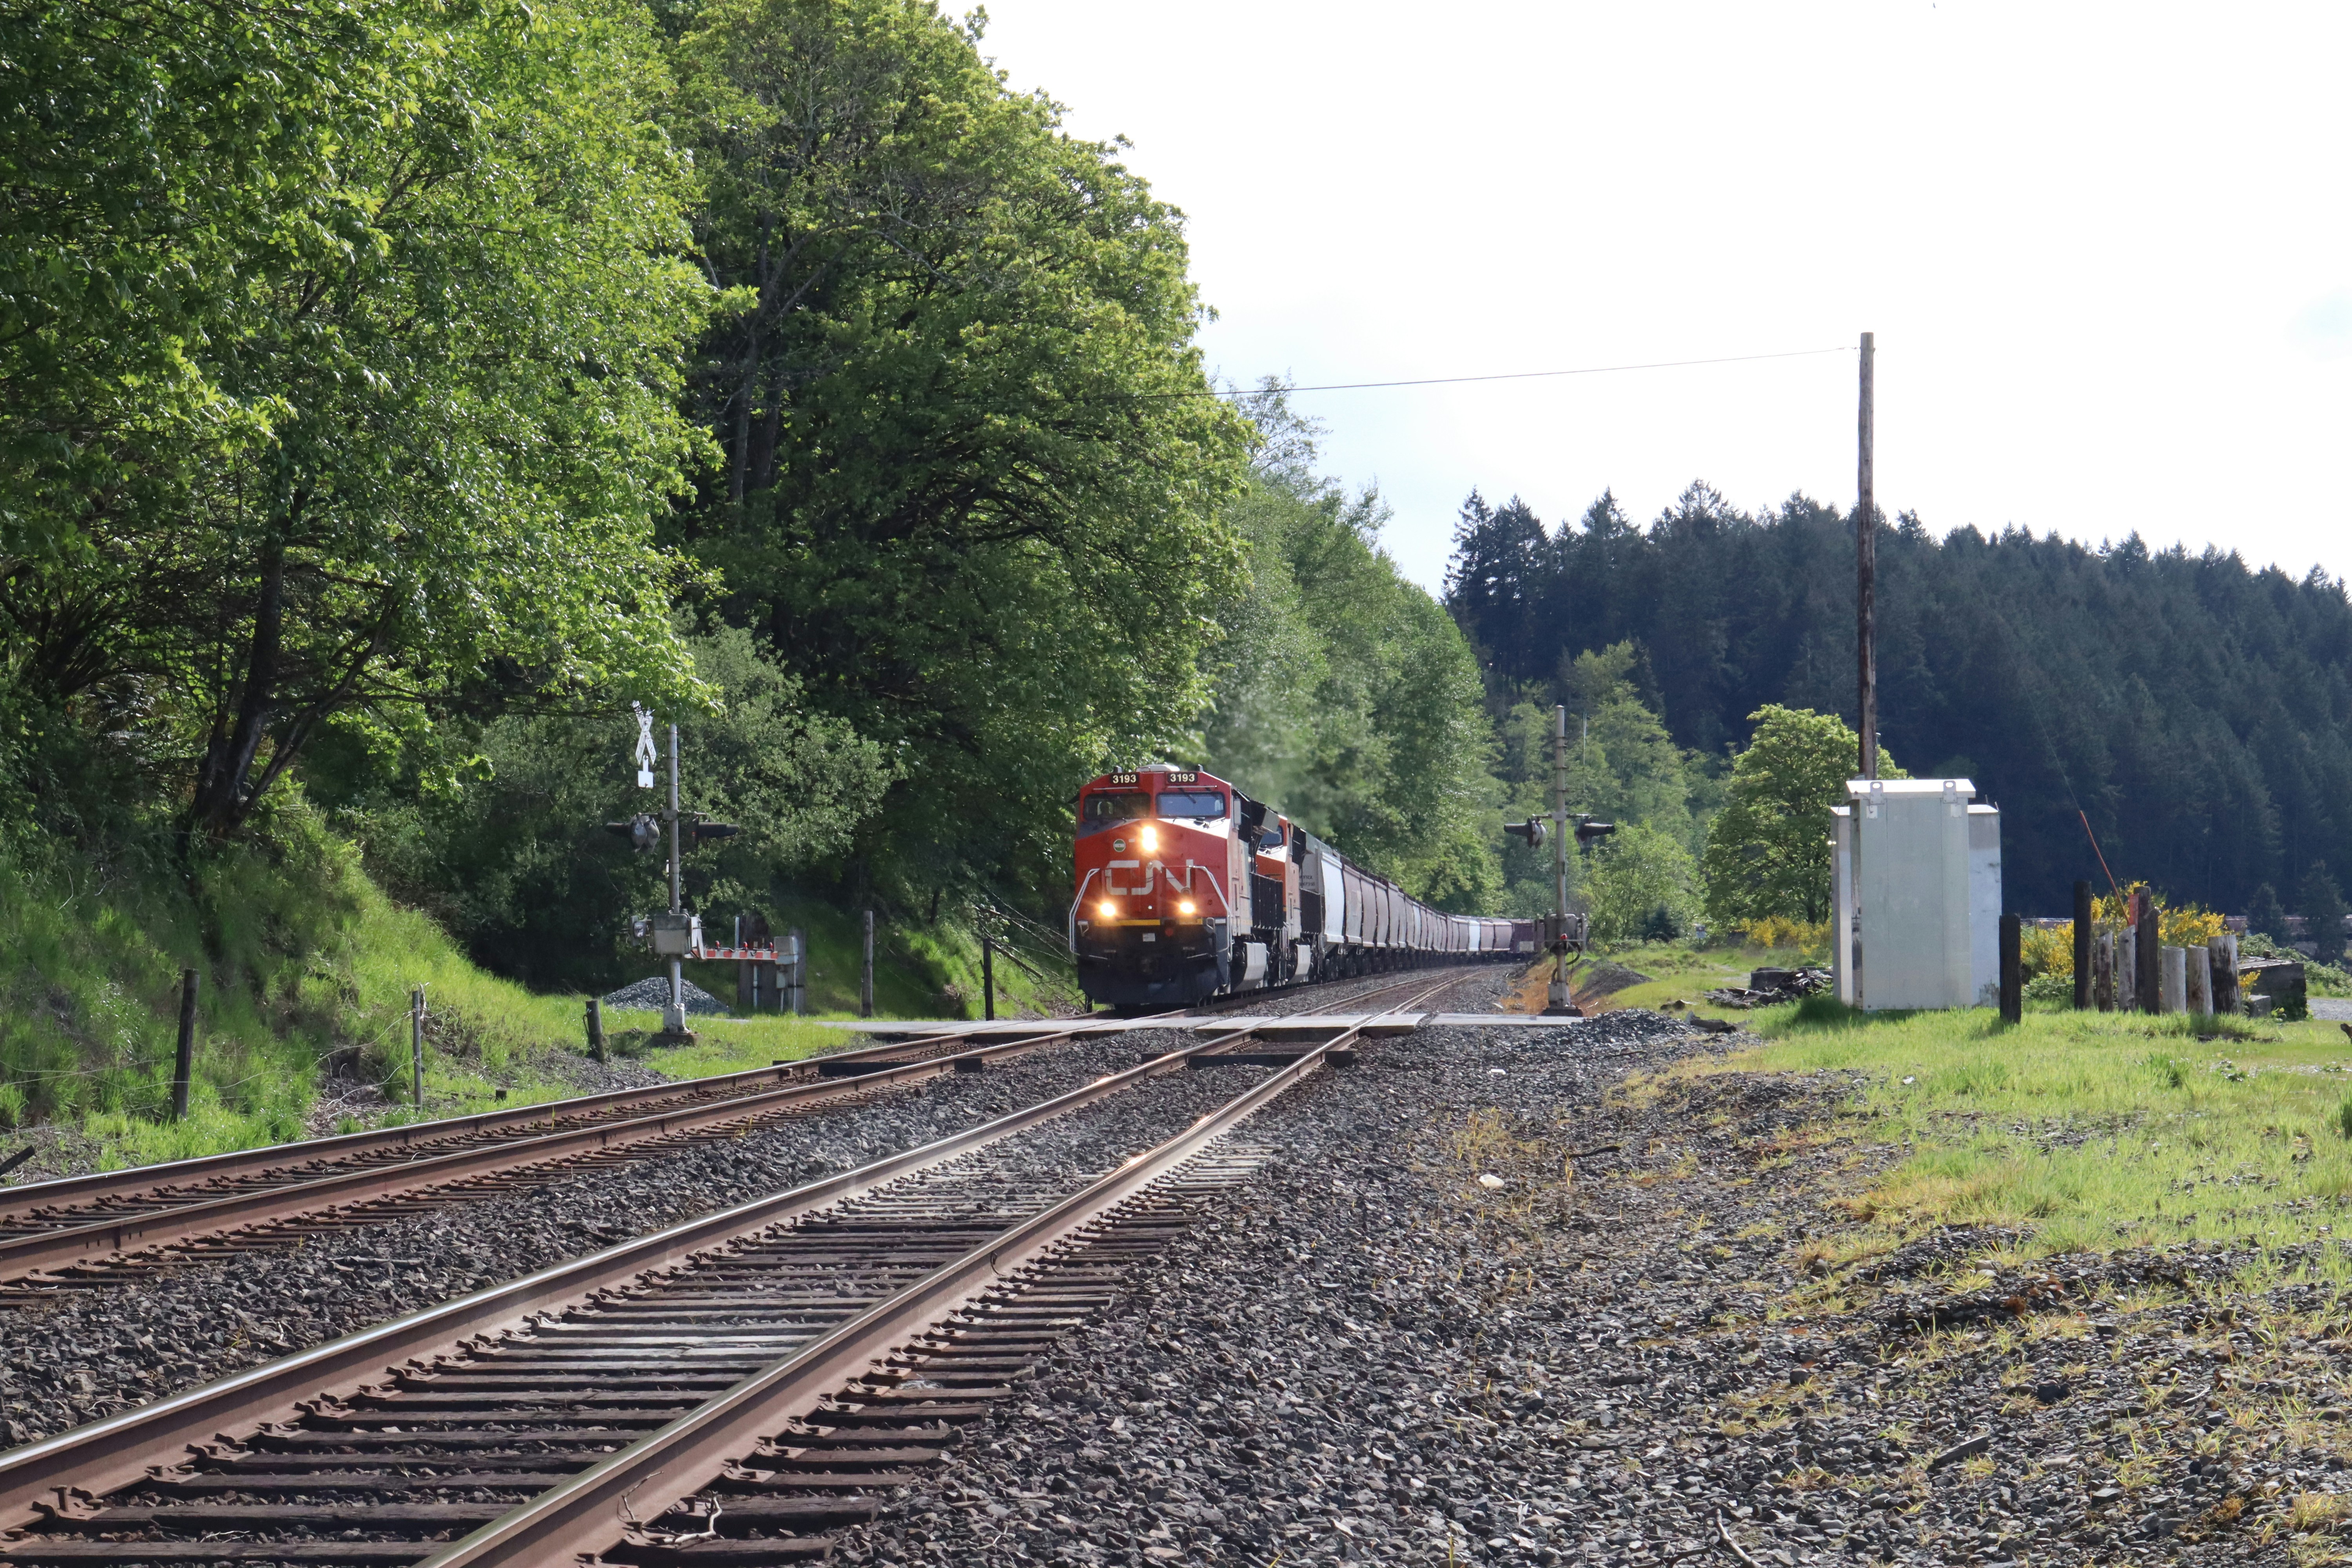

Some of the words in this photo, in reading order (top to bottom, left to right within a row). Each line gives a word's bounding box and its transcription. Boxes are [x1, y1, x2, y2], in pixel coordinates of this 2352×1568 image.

[1112, 774, 1136, 783] 3193
[1171, 773, 1195, 782] 3193
[1105, 859, 1193, 895] CN
